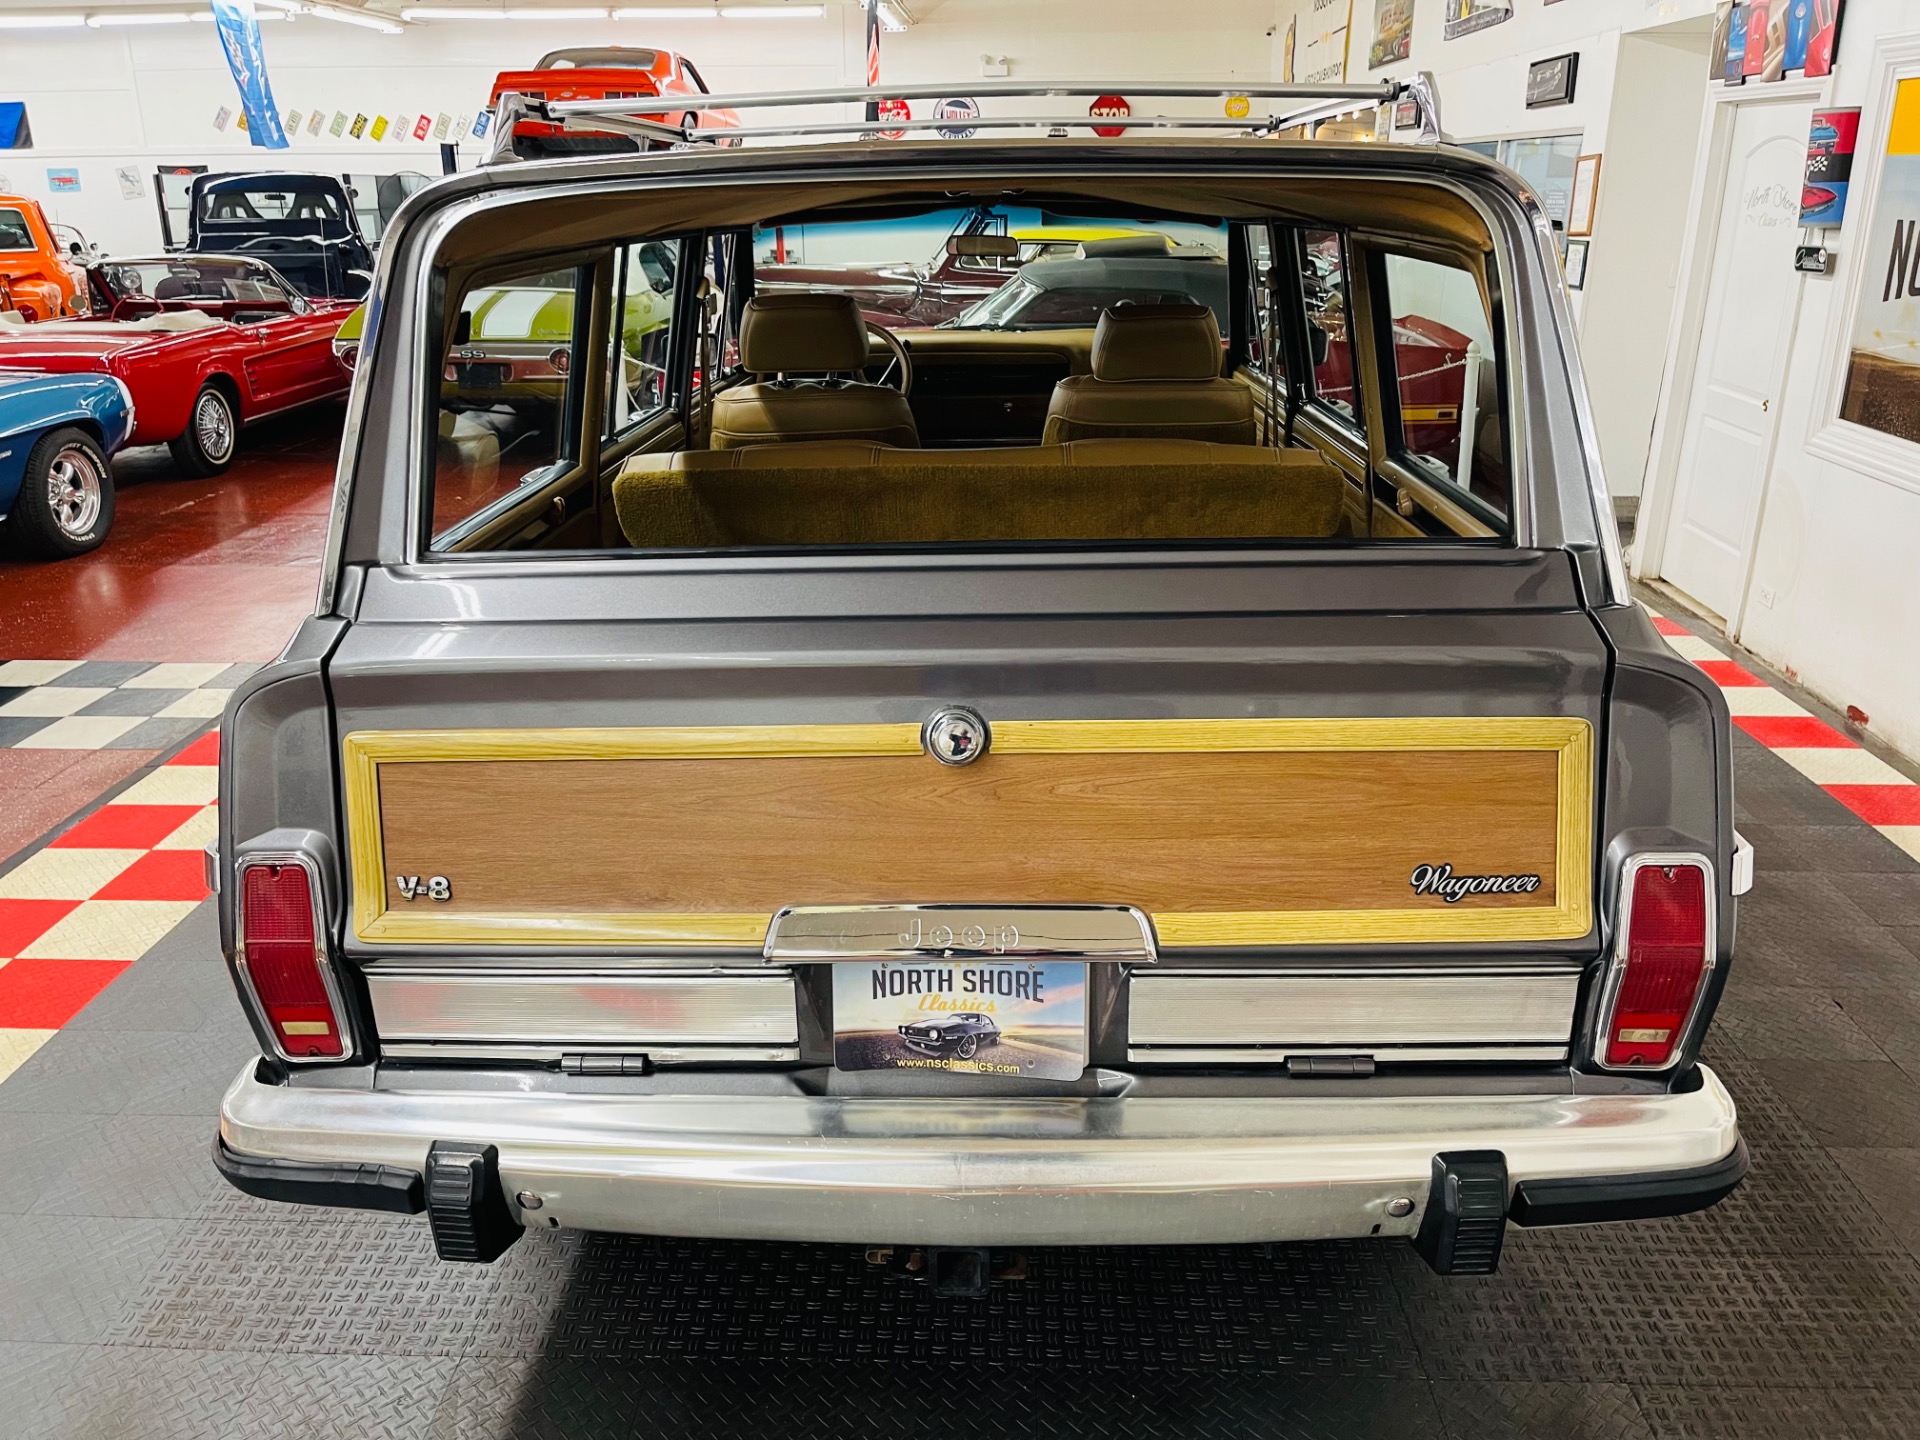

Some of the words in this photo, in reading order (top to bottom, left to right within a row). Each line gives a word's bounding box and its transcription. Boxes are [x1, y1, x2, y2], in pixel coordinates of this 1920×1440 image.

[460, 349, 486, 360] SS
[396, 875, 452, 902] V-8
[1410, 862, 1541, 904] Wagoneer
[898, 917, 1020, 954] Jeep
[872, 968, 954, 1000] NORTH
[962, 968, 1045, 1004] SHORE
[918, 993, 997, 1013] Classics
[896, 1058, 1020, 1075] www.nsclassics.com
